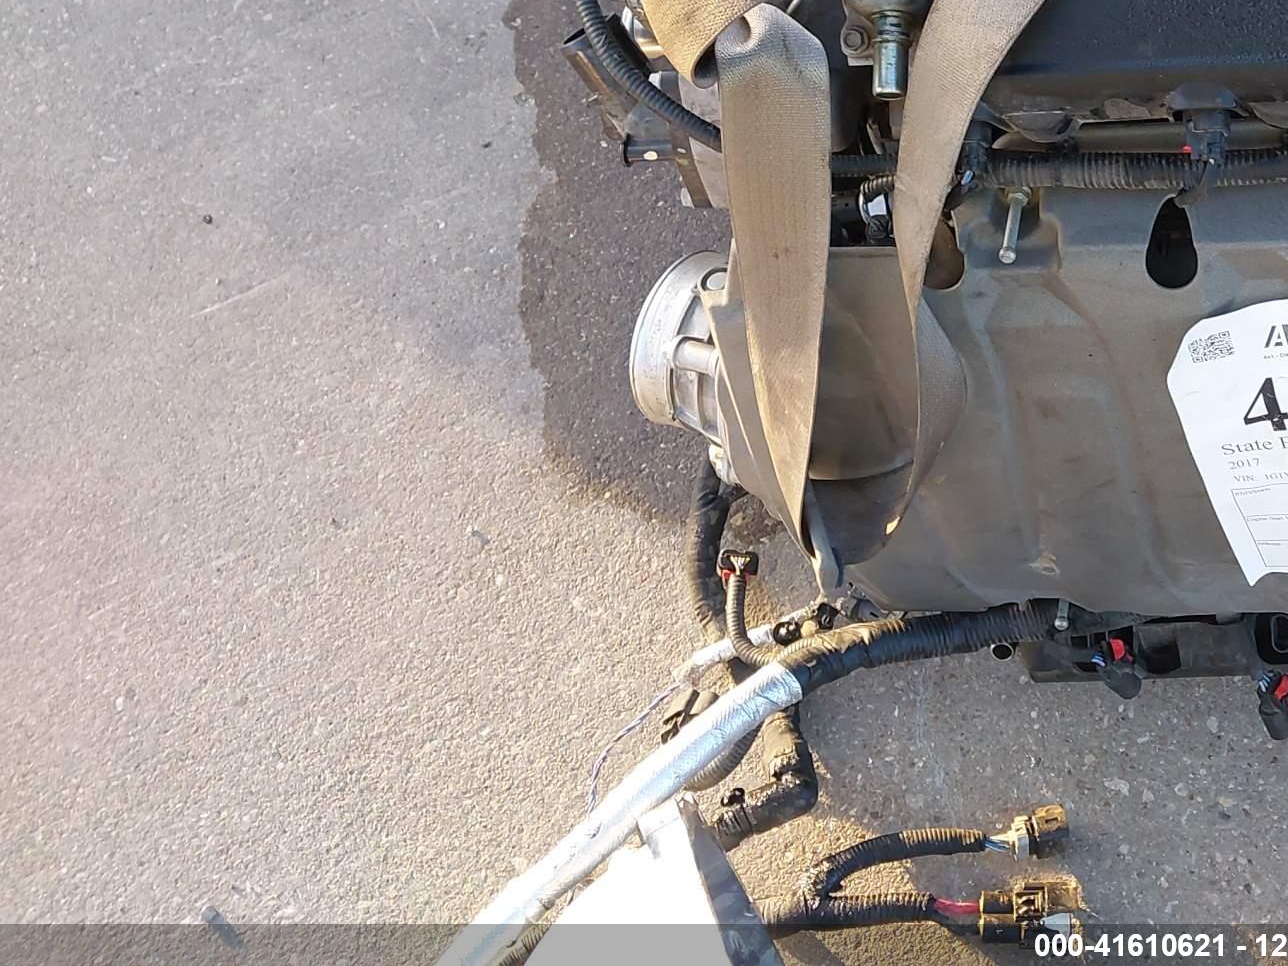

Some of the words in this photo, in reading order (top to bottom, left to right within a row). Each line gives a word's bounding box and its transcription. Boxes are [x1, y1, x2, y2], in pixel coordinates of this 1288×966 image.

[1221, 438, 1273, 456] State
[1228, 457, 1261, 470] 2017
[1233, 474, 1257, 483] VIN:
